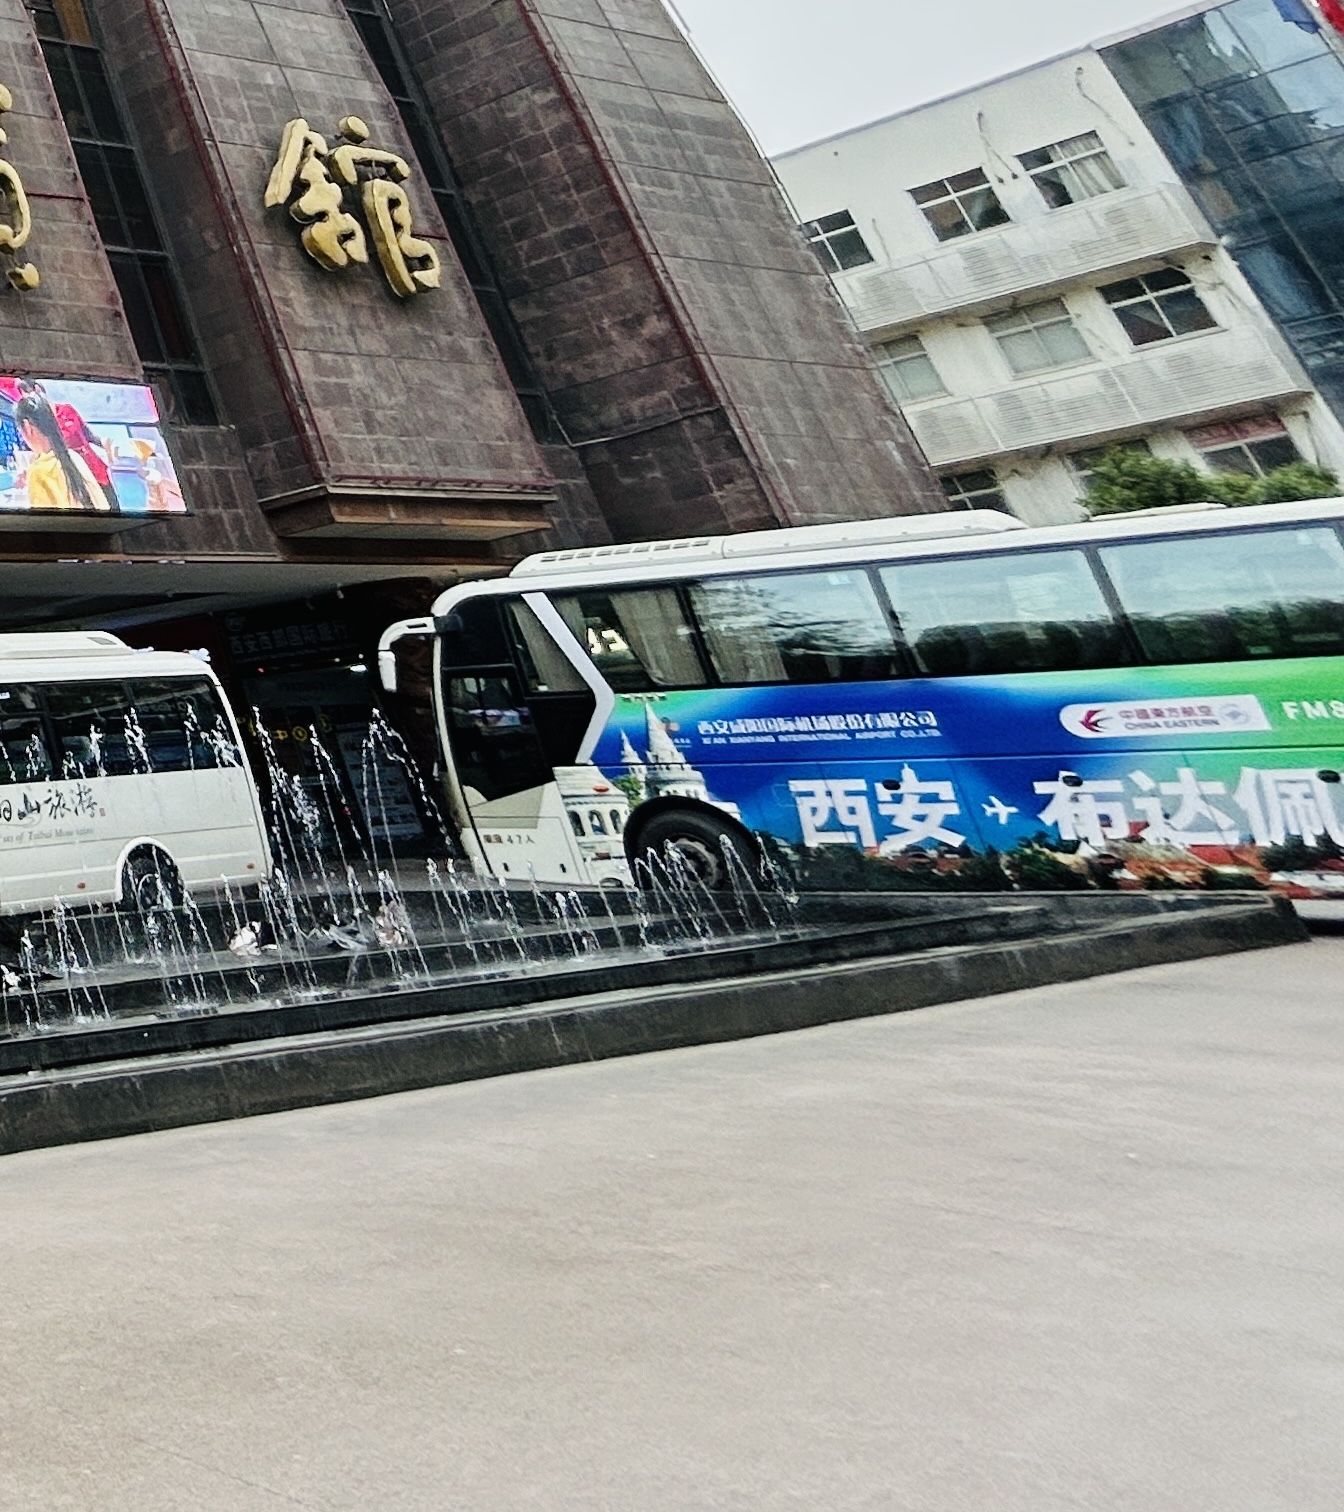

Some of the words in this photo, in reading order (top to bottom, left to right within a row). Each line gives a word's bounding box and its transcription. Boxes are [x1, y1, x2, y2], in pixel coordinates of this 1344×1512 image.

[1125, 721, 1162, 730] CHINA
[1164, 719, 1220, 729] EASTERN
[778, 731, 852, 742] INTERNATIONAL
[855, 730, 896, 739] AIRPORT
[788, 763, 966, 859] 西安
[1033, 766, 1344, 848] 布达佩
